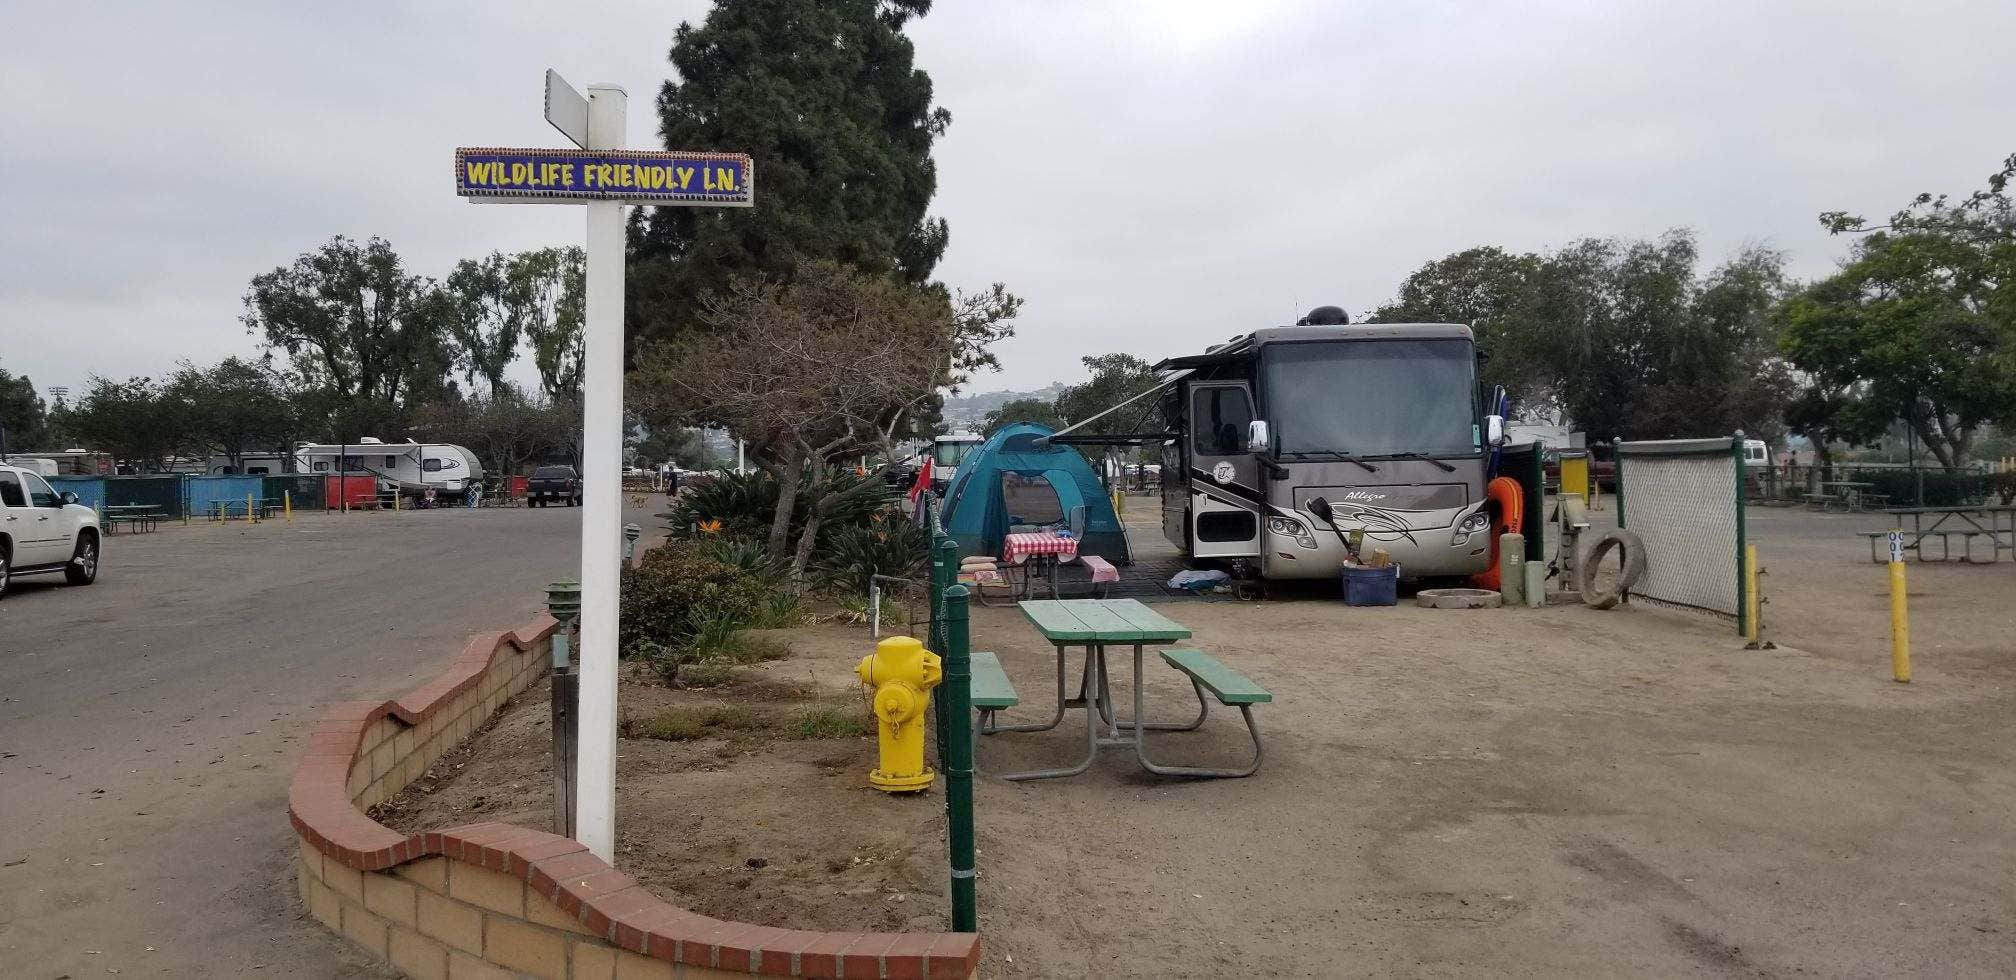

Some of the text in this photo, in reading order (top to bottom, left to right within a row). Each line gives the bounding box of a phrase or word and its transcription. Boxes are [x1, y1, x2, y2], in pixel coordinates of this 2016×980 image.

[467, 162, 741, 191] WILDLIFE FRIENDLY LN.
[1344, 491, 1387, 503] Allegro
